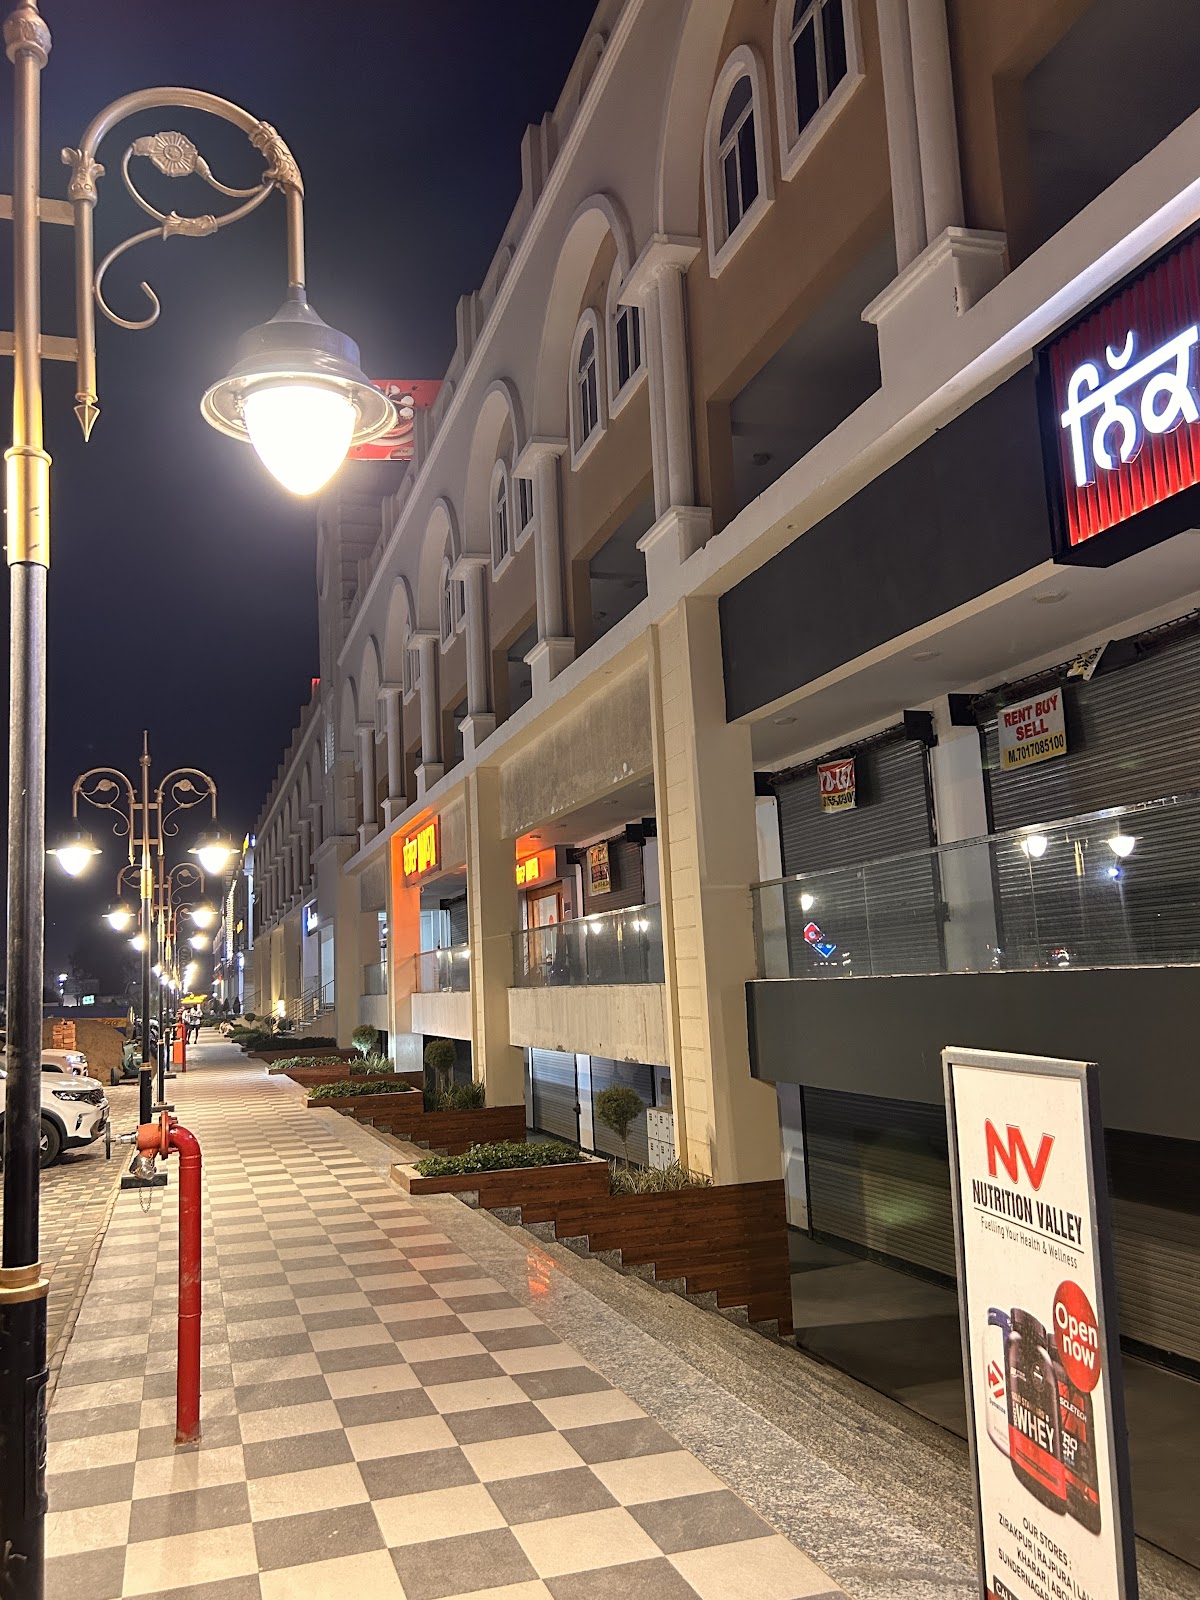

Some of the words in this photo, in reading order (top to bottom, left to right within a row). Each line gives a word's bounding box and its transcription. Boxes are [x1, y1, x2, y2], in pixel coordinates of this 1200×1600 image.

[1004, 705, 1032, 728] RENT
[1035, 695, 1058, 717] BUY
[1016, 719, 1049, 742] SELL
[1008, 734, 1064, 763] M.7017085100
[972, 1178, 1033, 1225] NUTRITION
[1036, 1200, 1082, 1246] VALLEY
[980, 1216, 1005, 1239] Fuelling
[1006, 1226, 1019, 1242] Your
[1020, 1232, 1041, 1252] Health
[1042, 1240, 1048, 1254] &
[1048, 1244, 1078, 1269] Wellness
[1055, 1302, 1098, 1348] Open
[1062, 1334, 1095, 1370] now
[1016, 1404, 1054, 1453] WHEY
[1022, 1517, 1039, 1540] OUR
[998, 1512, 1033, 1553] ZIRAKPUR
[1037, 1548, 1072, 1588] RAJPURA
[1017, 1546, 1046, 1584] KHARAR
